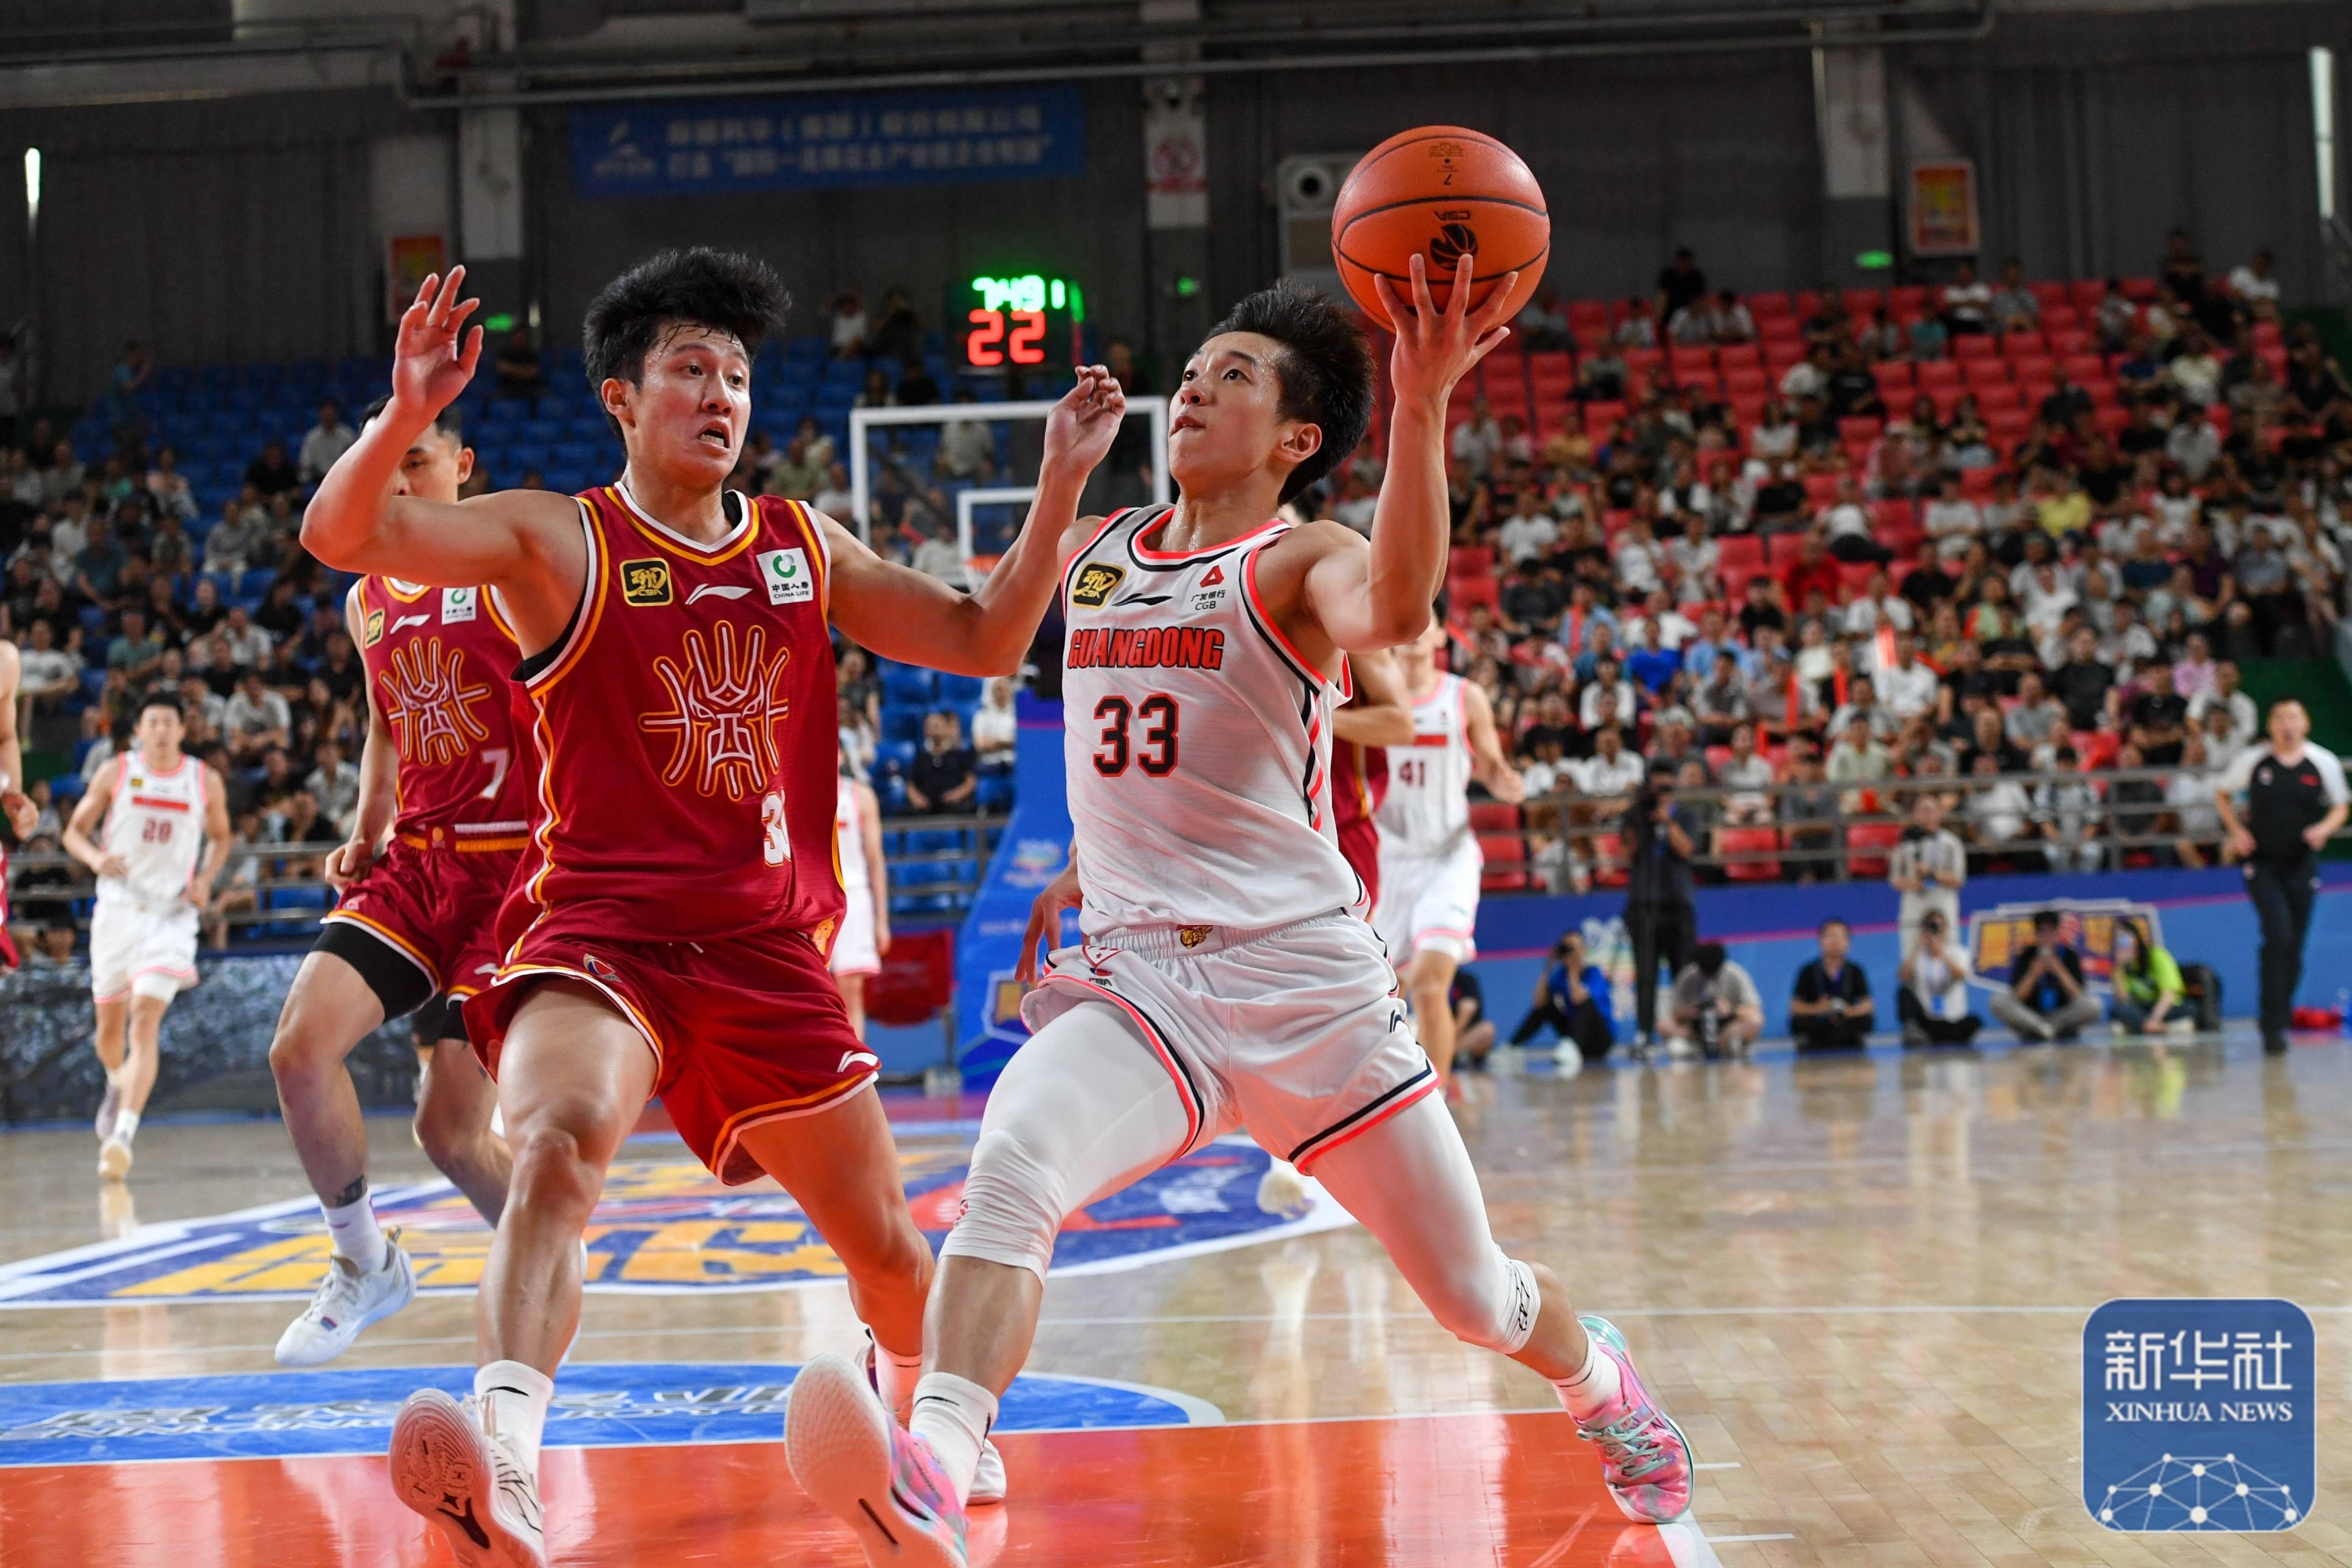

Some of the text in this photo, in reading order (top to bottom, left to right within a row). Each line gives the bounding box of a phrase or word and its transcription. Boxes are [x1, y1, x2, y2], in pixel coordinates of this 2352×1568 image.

[968, 308, 1046, 366] 22
[1191, 590, 1225, 602] 广发银行
[1195, 602, 1216, 610] CGB
[1067, 627, 1224, 671] GUANGDONG
[1093, 693, 1179, 778] 33
[480, 748, 510, 801] 7
[1399, 759, 1426, 789] 41
[762, 788, 792, 867] 3
